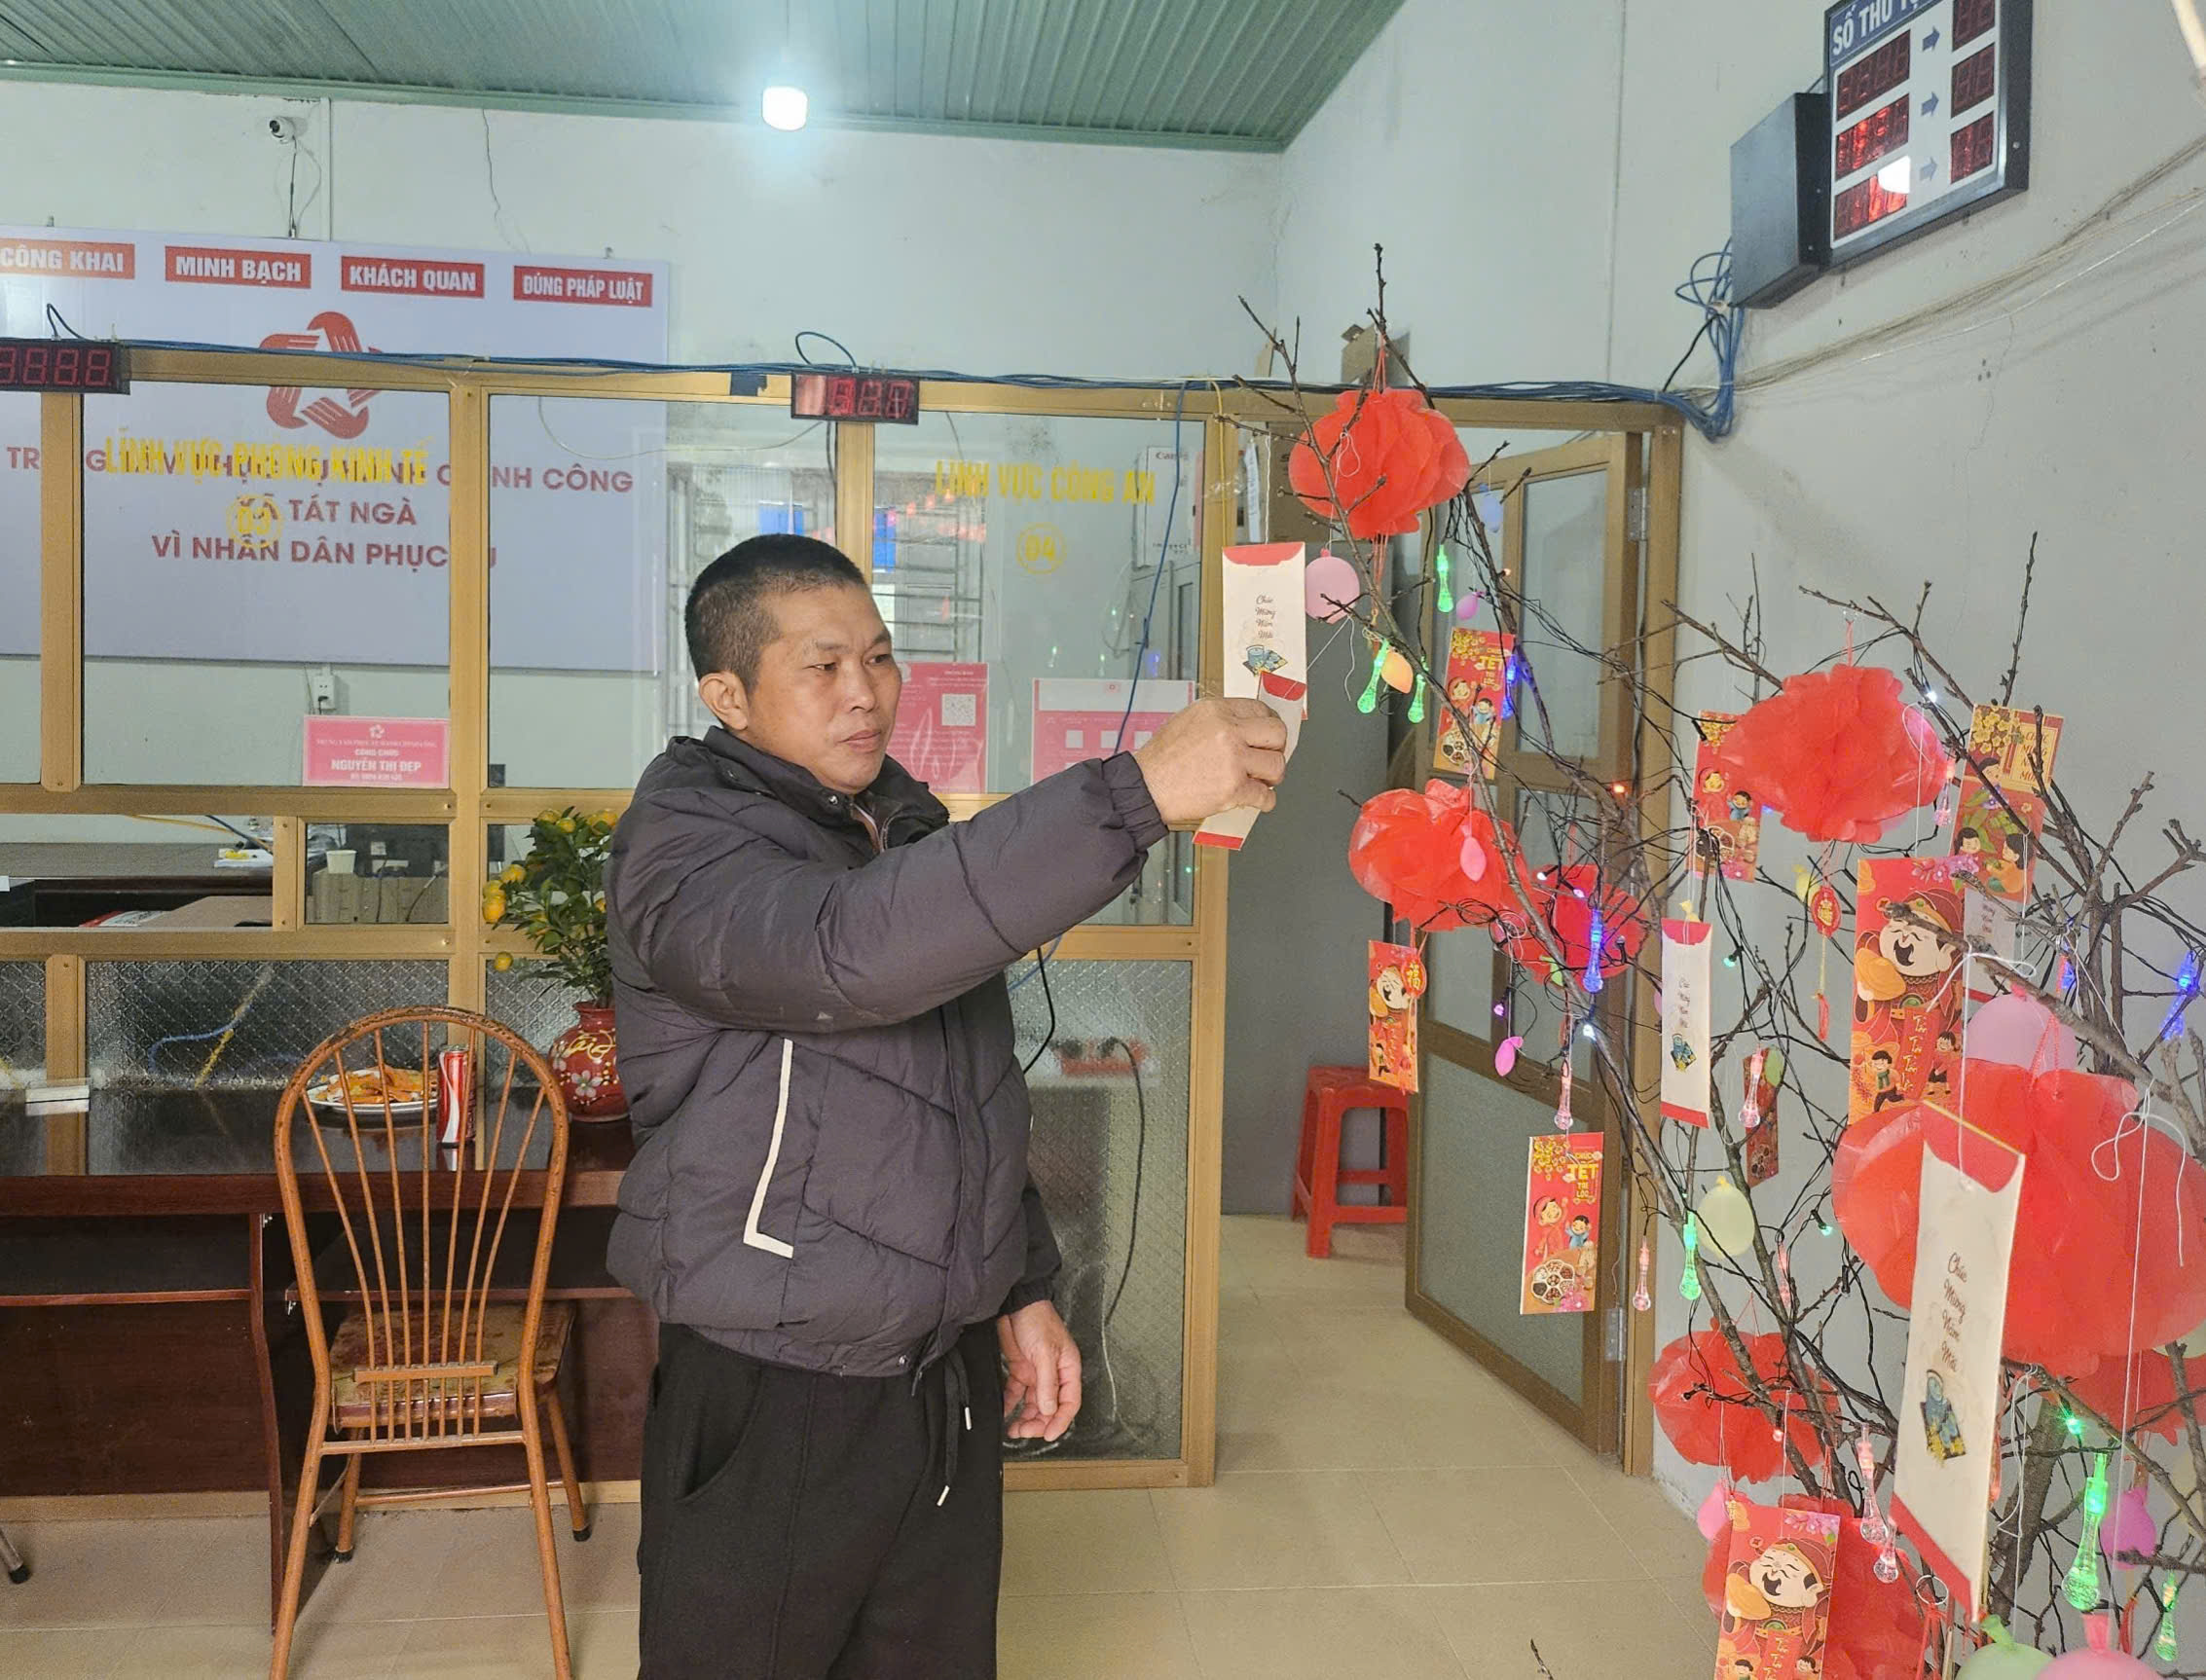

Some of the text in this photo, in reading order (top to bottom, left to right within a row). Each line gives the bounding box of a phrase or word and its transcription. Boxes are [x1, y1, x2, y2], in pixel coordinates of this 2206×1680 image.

[1833, 8, 1857, 55] SỐ
[0, 244, 124, 274] CÔNG KHAI
[176, 256, 302, 284] MINH BẠCH
[349, 263, 476, 292] KHÁCH QUAN
[522, 272, 644, 304] ĐÚNG PHÁP LUẬT
[7, 446, 107, 473] TRG
[437, 464, 533, 489] CNH
[542, 462, 634, 493] CÔNG
[1121, 470, 1157, 507] AN
[350, 497, 417, 526] NGÀ
[151, 530, 448, 573] VÌ NHÂN DÂN PHỤC
[1024, 534, 1056, 562] 04
